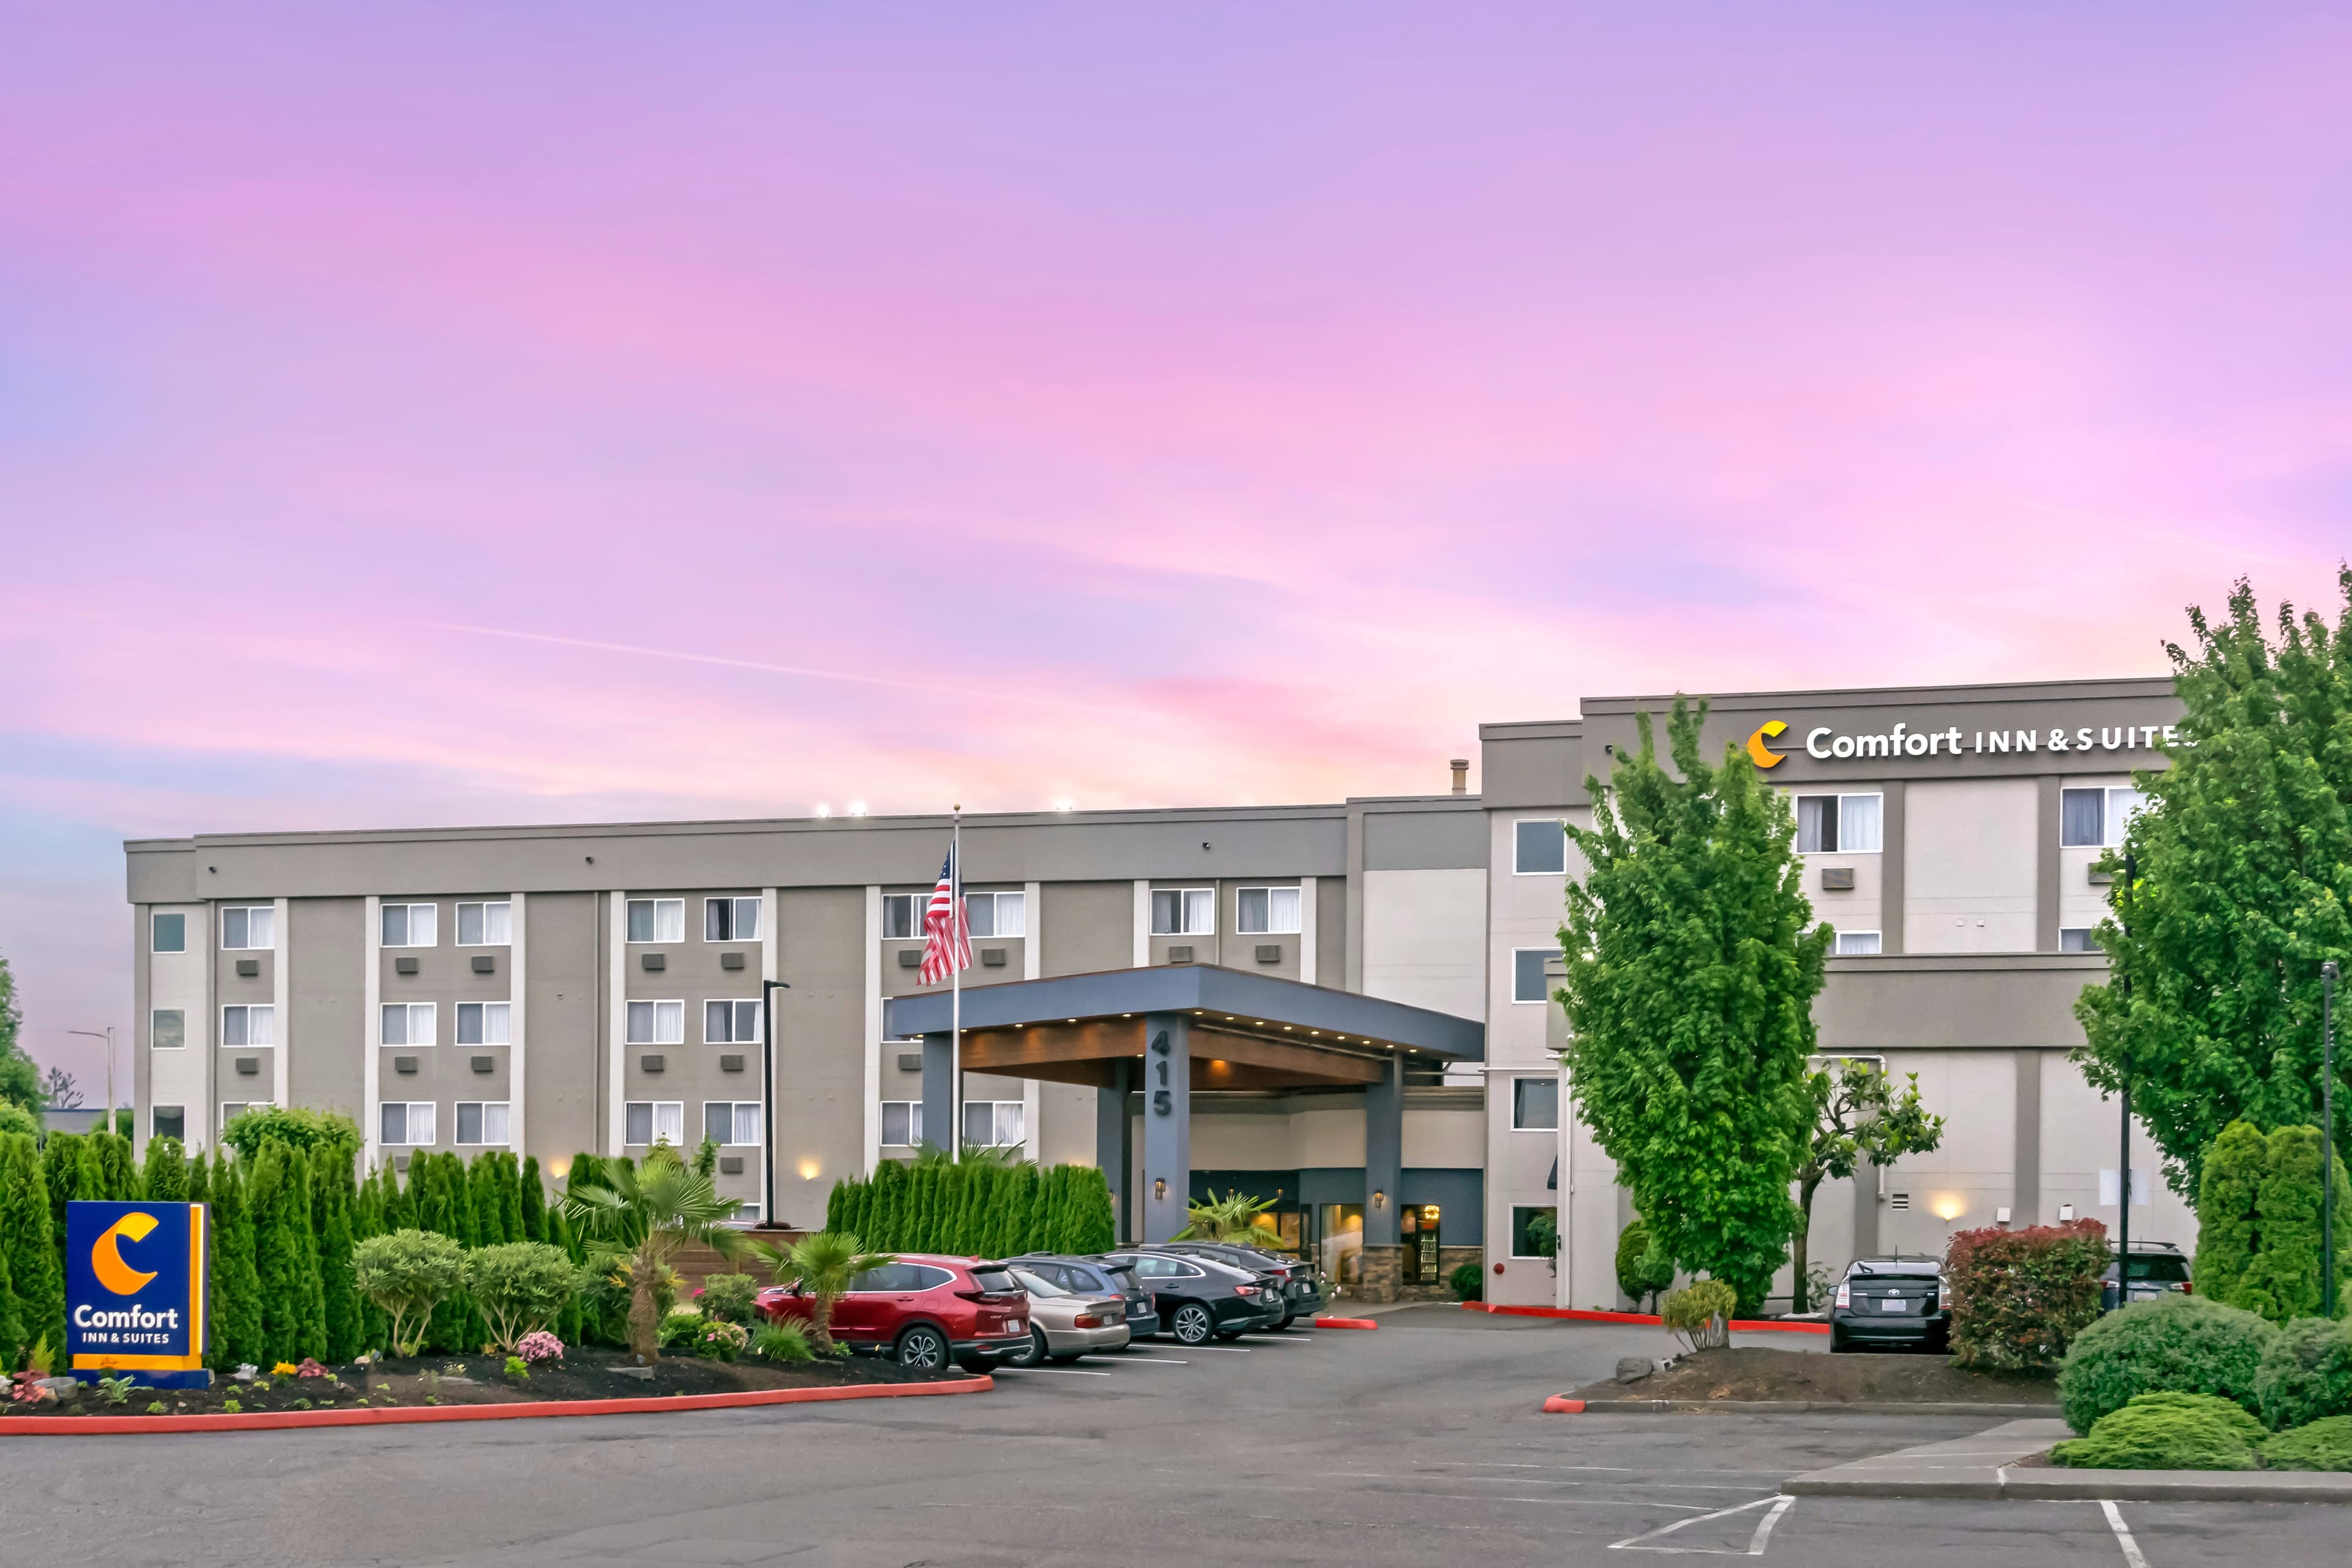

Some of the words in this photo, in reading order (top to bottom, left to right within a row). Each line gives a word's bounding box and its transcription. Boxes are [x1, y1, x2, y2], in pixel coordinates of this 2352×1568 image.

[1806, 723, 1962, 759] Comfort
[1975, 729, 2037, 753] INN
[2048, 728, 2070, 751] &
[1152, 1030, 1171, 1117] 415
[74, 1304, 178, 1329] Comfort
[82, 1332, 107, 1343] INN
[111, 1332, 120, 1343] &
[123, 1333, 169, 1344] SUITES
